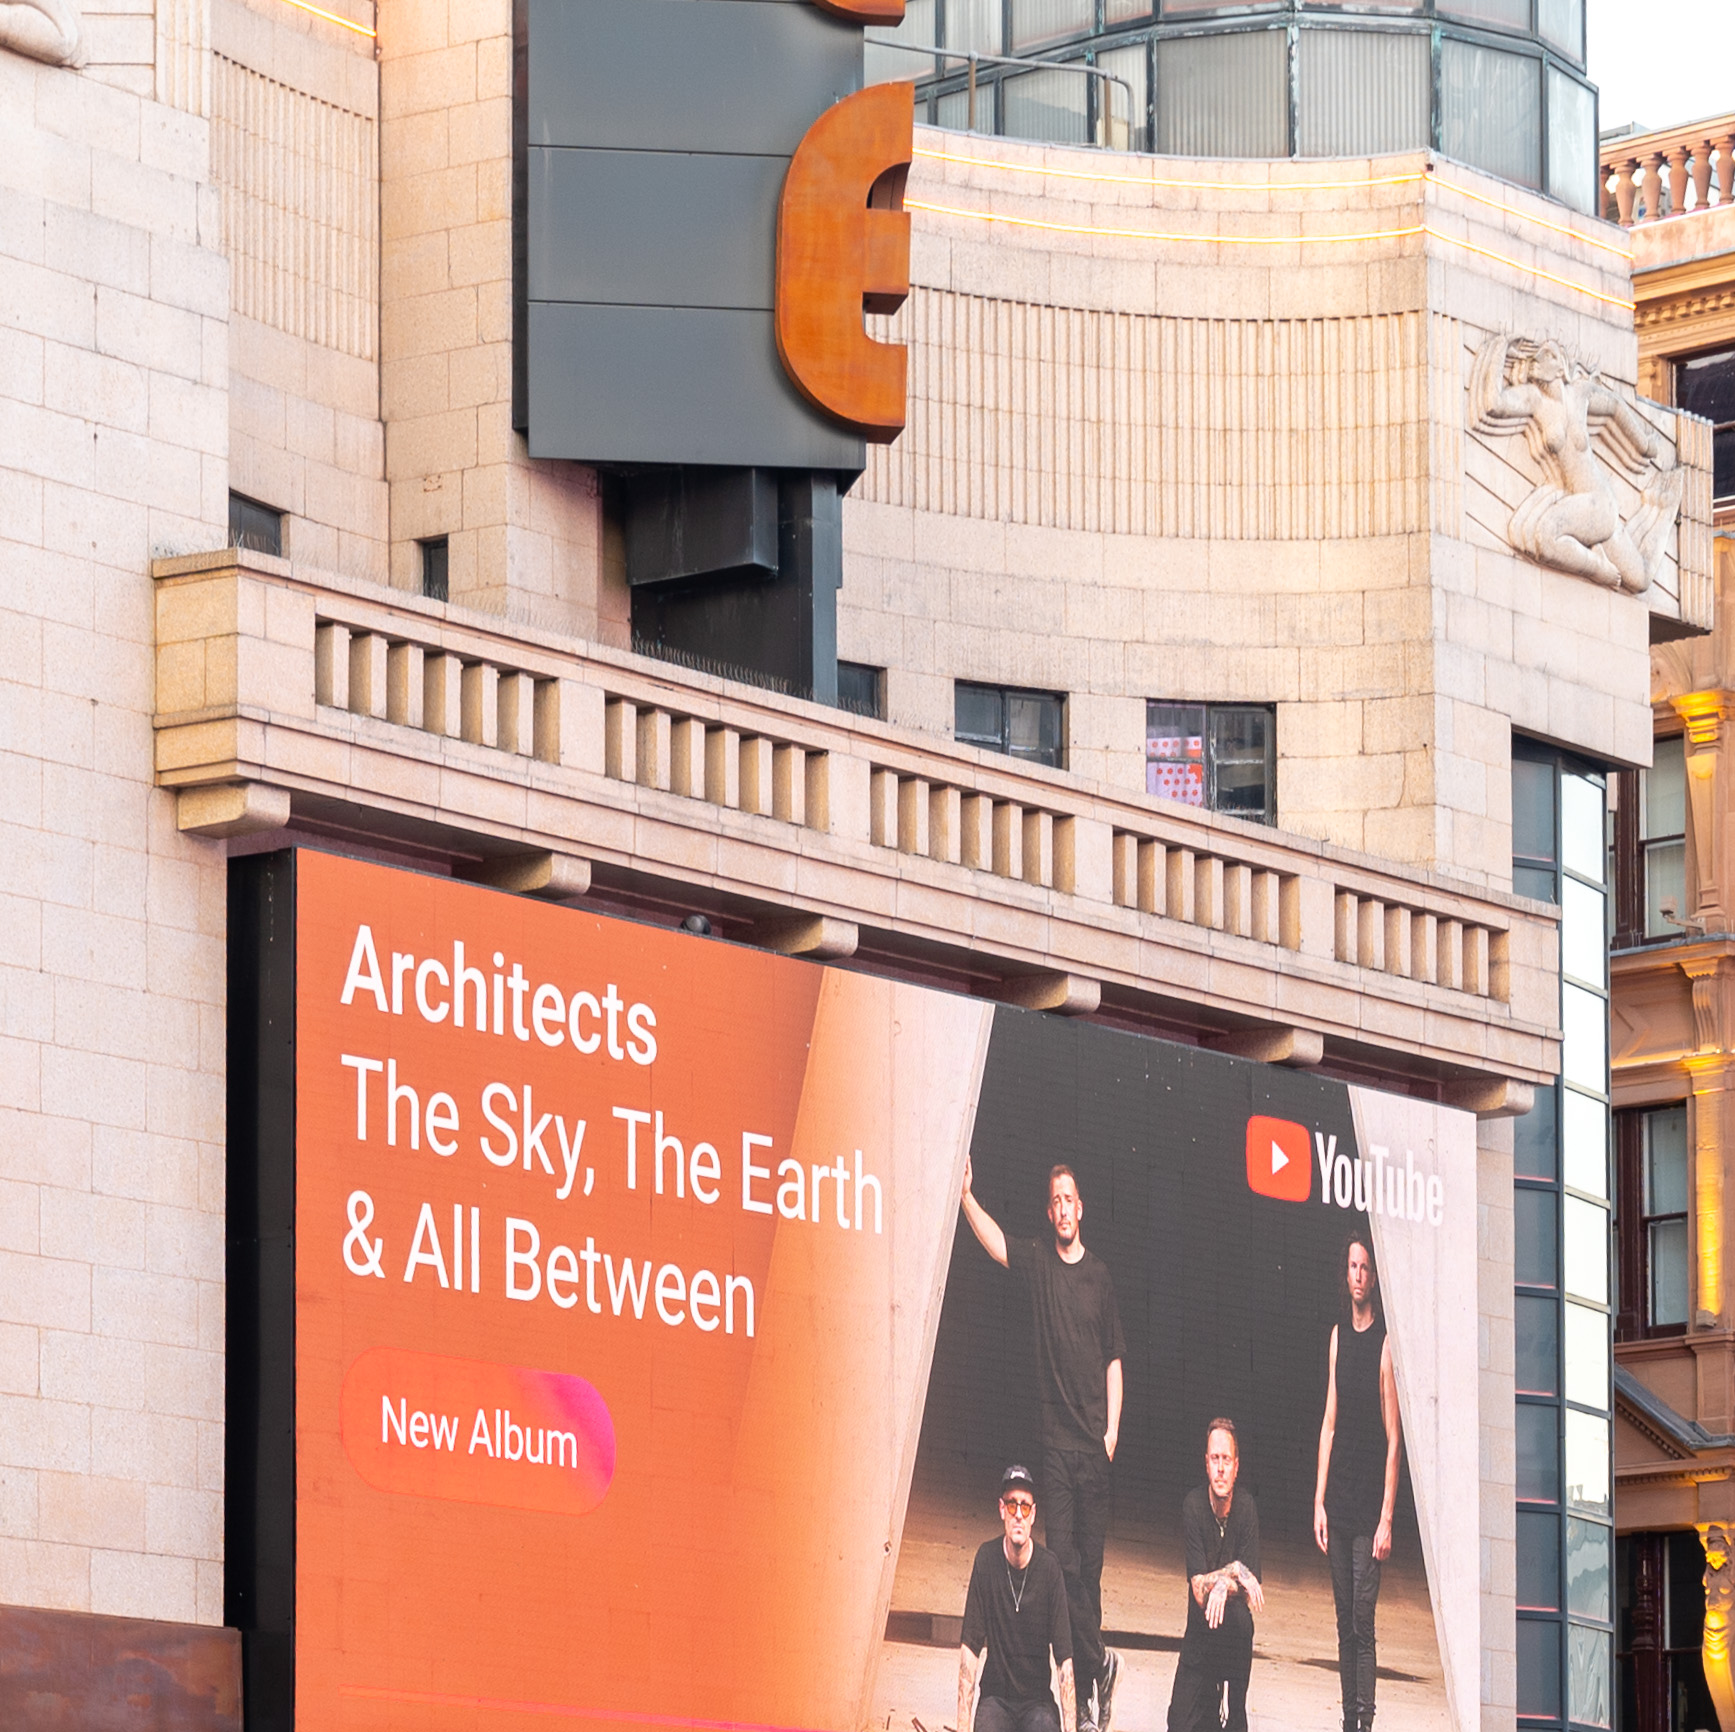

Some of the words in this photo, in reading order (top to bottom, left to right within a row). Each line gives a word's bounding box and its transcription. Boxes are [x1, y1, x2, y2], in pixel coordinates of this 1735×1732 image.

[340, 924, 658, 1068] Architects
[340, 1053, 461, 1158] The
[479, 1081, 596, 1200] Sky,
[611, 1105, 720, 1197] The
[741, 1132, 883, 1236] Earth
[1315, 1131, 1445, 1228] YouTube
[342, 1192, 385, 1280] &
[404, 1202, 483, 1296] All
[505, 1215, 756, 1340] Between
[380, 1396, 459, 1455] New
[467, 1406, 579, 1470] Album
